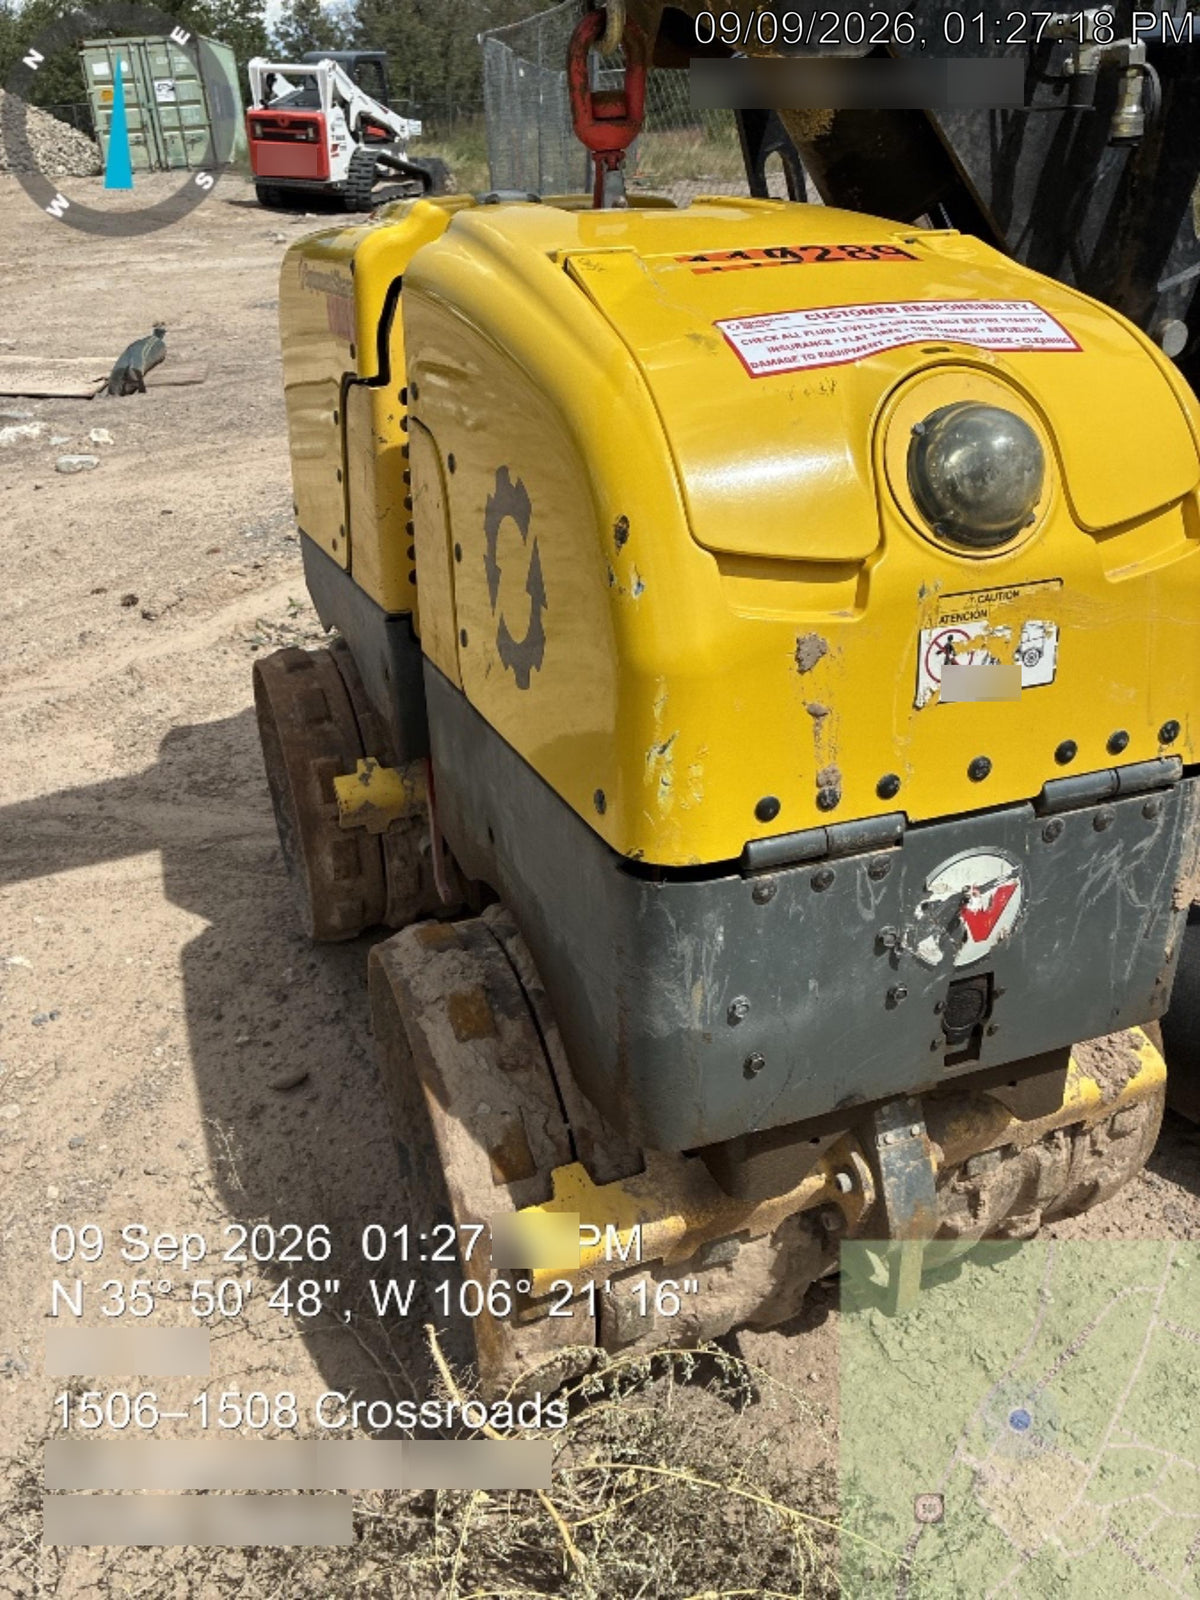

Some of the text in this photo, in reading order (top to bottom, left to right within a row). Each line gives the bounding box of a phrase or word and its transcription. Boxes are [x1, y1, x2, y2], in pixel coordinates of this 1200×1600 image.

[804, 307, 899, 321] CUSTOMER
[741, 335, 779, 346] CHECK
[782, 332, 802, 340] ALL
[767, 339, 833, 355] INSURANCE
[841, 334, 869, 344] FLAT
[750, 354, 801, 369] DAMAGE
[802, 352, 817, 361] TO
[817, 340, 884, 358] EQUIPMENT
[977, 590, 1020, 604] CAUTION
